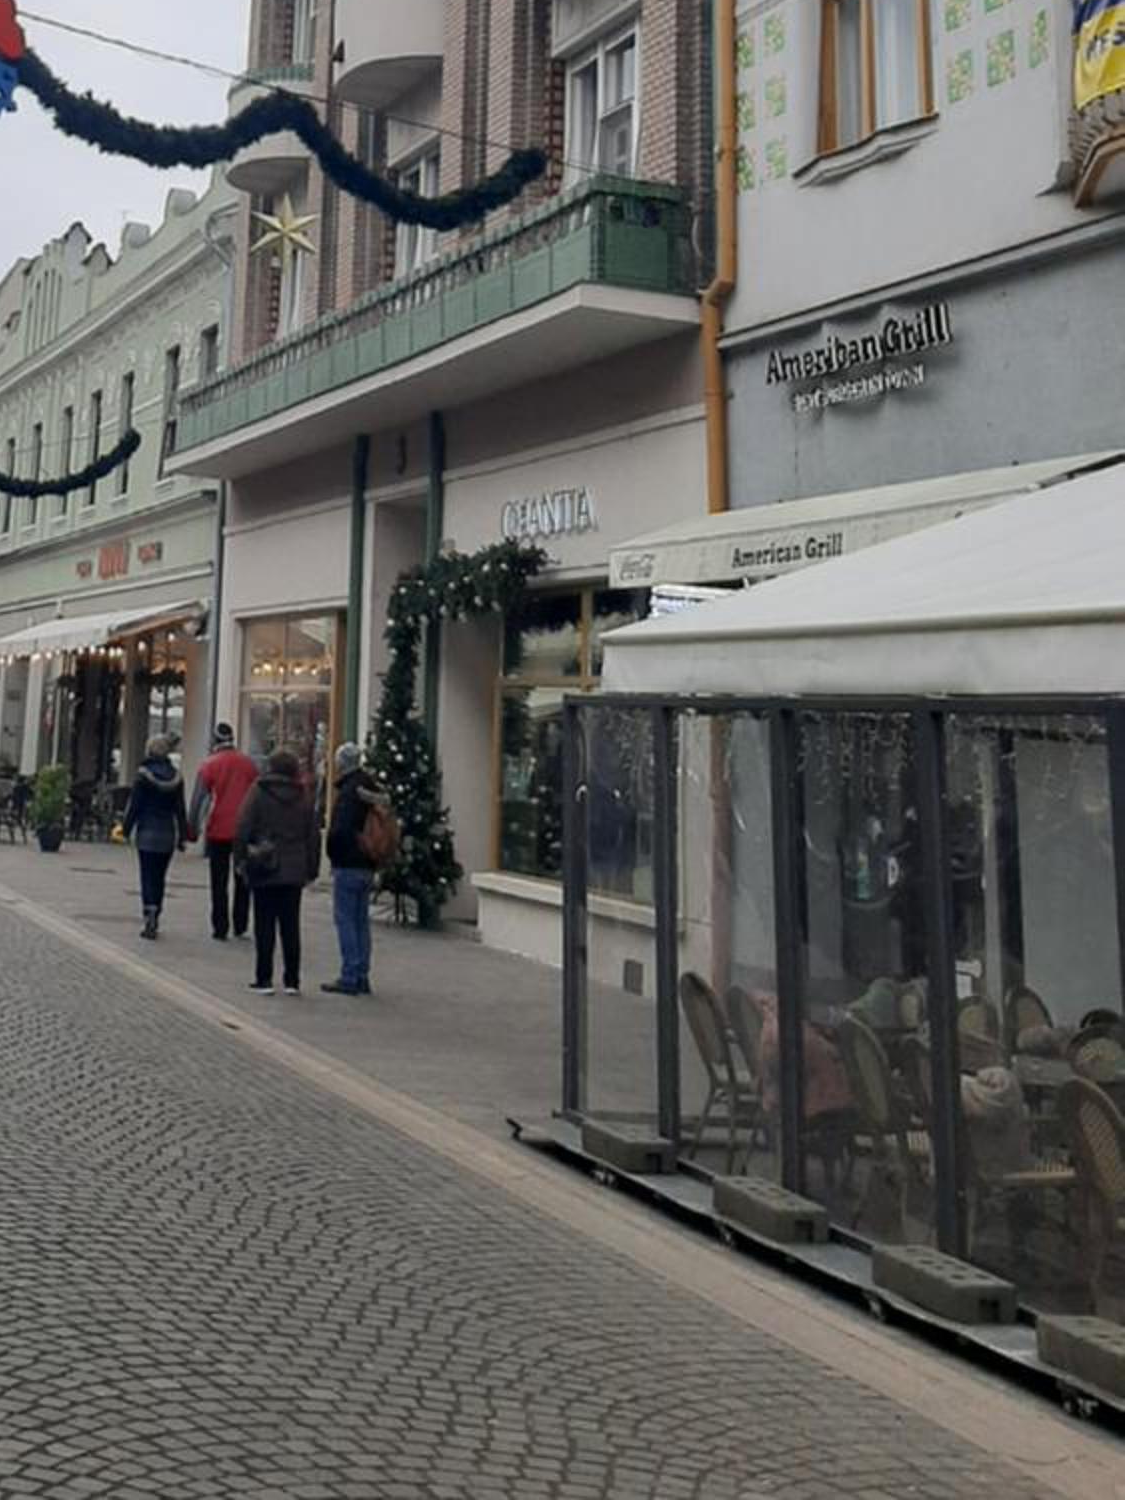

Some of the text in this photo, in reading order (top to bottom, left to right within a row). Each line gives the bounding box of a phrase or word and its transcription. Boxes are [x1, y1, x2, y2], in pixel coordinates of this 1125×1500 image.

[883, 301, 954, 354] Grill
[732, 531, 843, 568] American Grill
